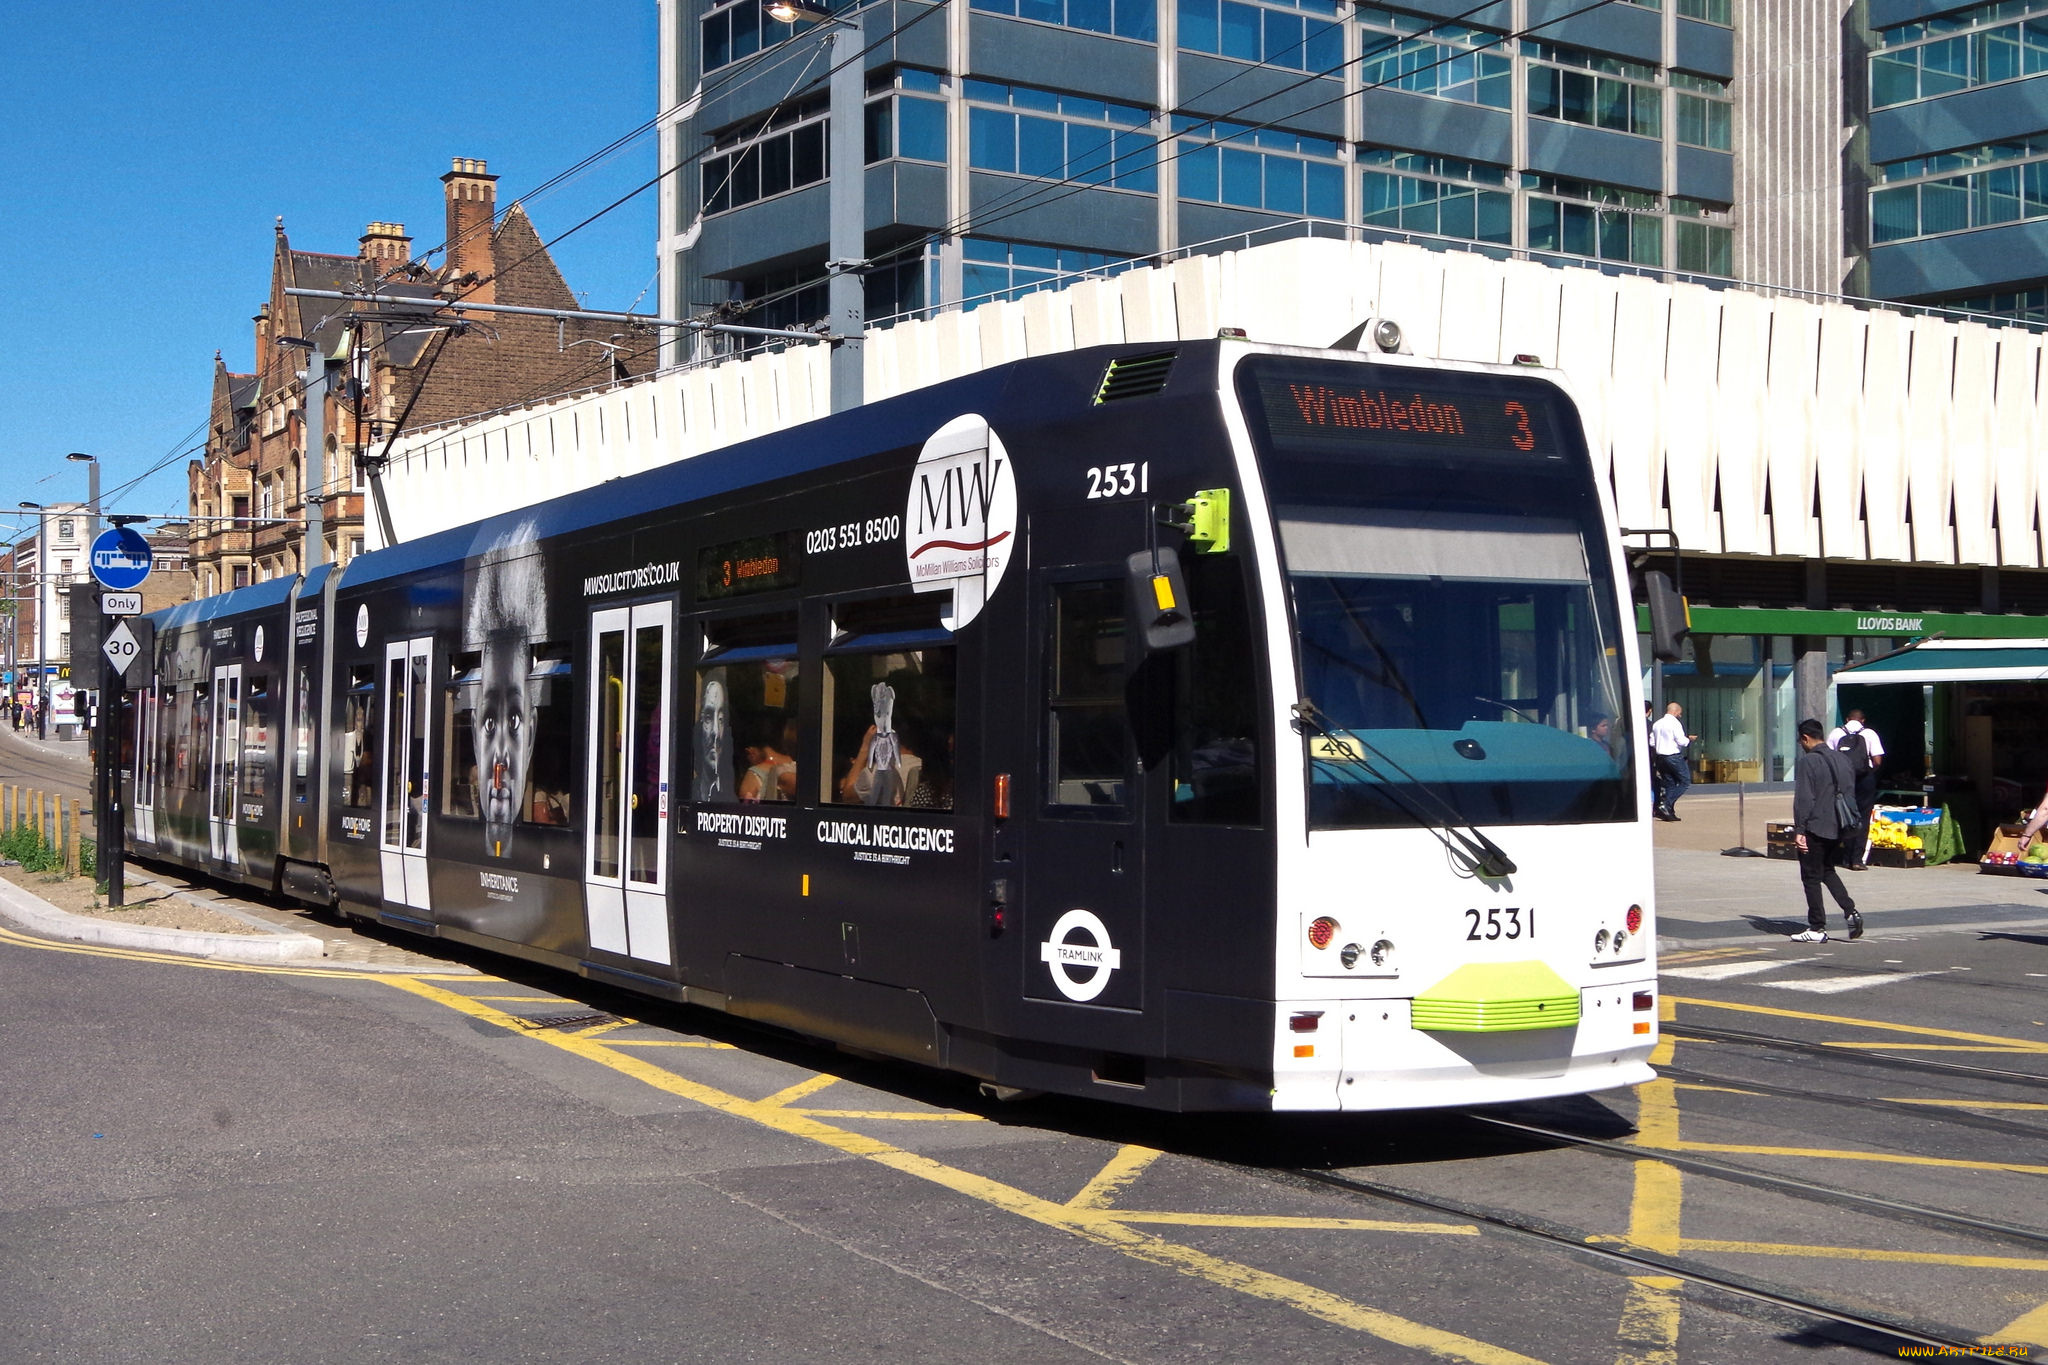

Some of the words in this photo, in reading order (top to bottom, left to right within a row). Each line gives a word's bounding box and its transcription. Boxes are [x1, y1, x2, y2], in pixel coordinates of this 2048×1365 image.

[1289, 384, 1465, 435] Wimbledon
[1504, 401, 1535, 451] 3
[1086, 460, 1148, 500] 2531
[918, 459, 1003, 534] MW
[806, 527, 836, 555] 0203
[839, 522, 862, 548] 551
[865, 514, 900, 544] 8500
[583, 561, 680, 597] MWSOLICITORS.CO.UK
[723, 560, 731, 586] 3
[736, 556, 779, 578] Wimbledon
[108, 598, 136, 610] Only
[1857, 617, 1895, 630] LLOYDS
[1895, 618, 1923, 631] BANK
[109, 641, 134, 656] 30
[697, 812, 744, 835] PROPERTY
[744, 815, 787, 839] DISPUTE
[817, 820, 871, 846] CLINICAL
[872, 824, 954, 853] NEGLIGENCE
[480, 871, 518, 893] INHERITANCE
[1465, 907, 1535, 941] 2531
[1058, 948, 1103, 963] TRAMLINK
